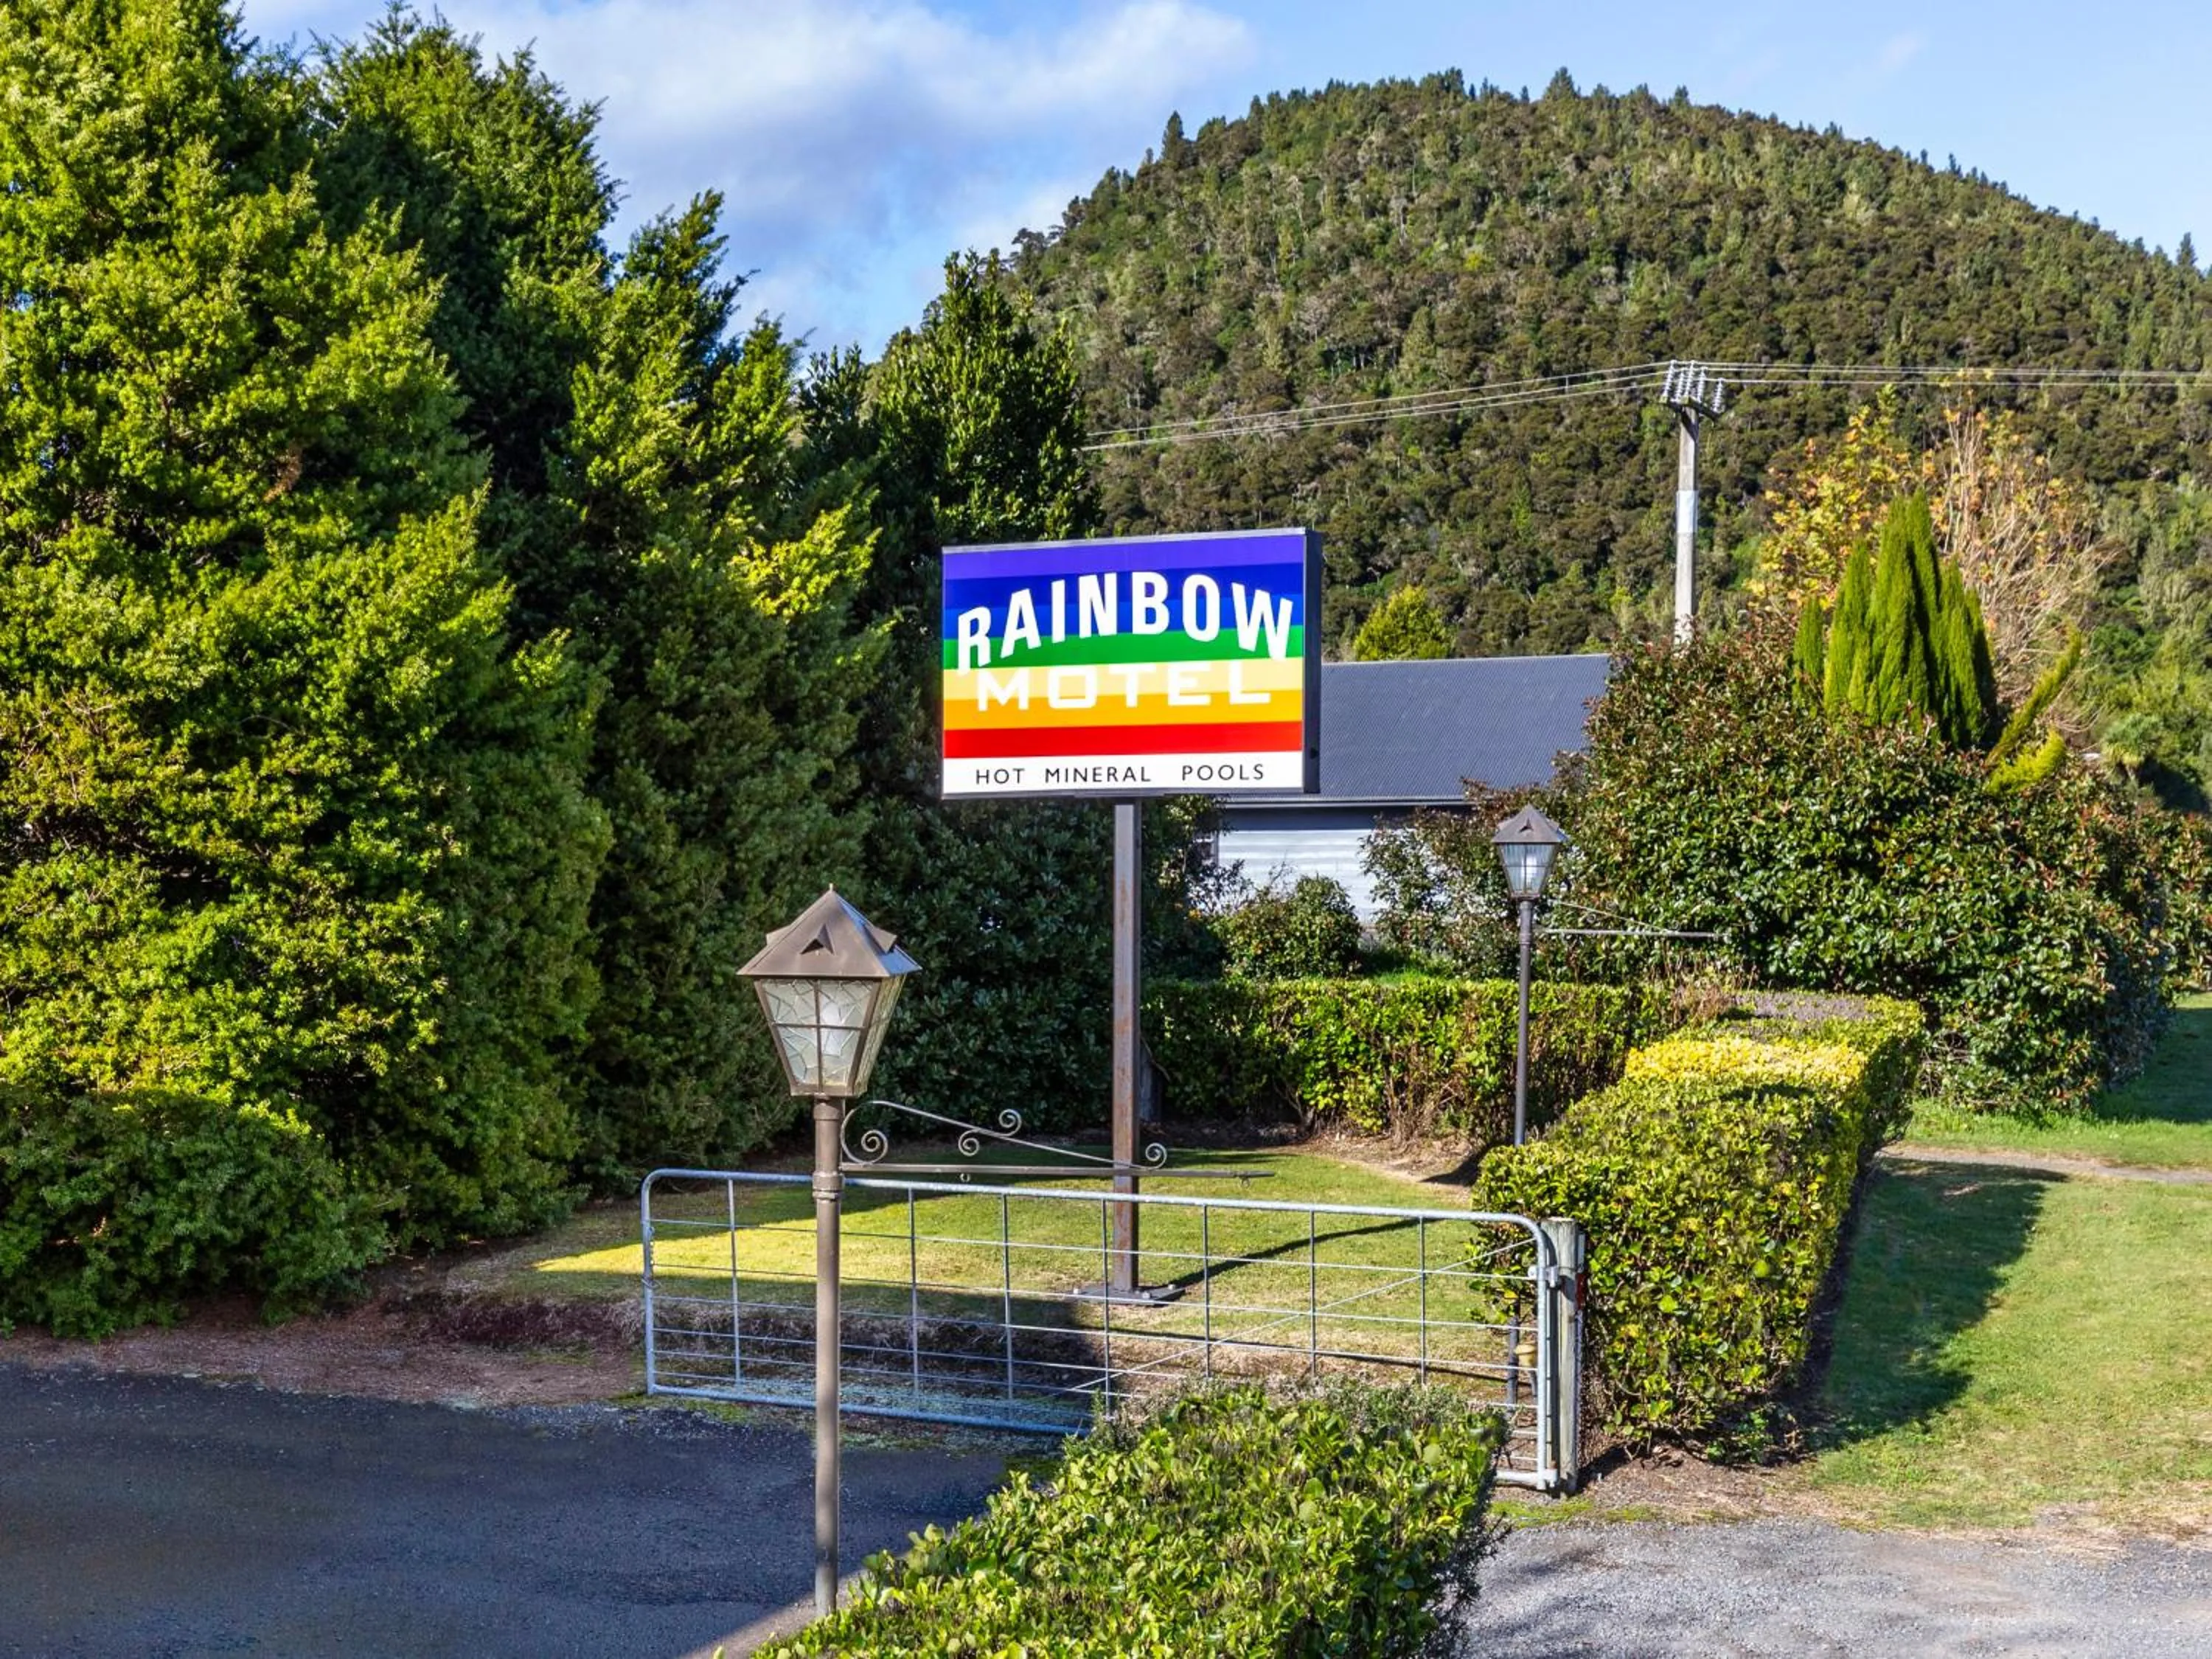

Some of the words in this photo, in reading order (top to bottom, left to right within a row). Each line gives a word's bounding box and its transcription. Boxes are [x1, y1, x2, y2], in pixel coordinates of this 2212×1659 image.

[958, 571, 1294, 675] RAINBOW
[977, 661, 1272, 712] MOTEL
[975, 768, 1026, 785] HOT
[1044, 765, 1152, 784] MINERAL
[1182, 763, 1265, 781] POOLS
